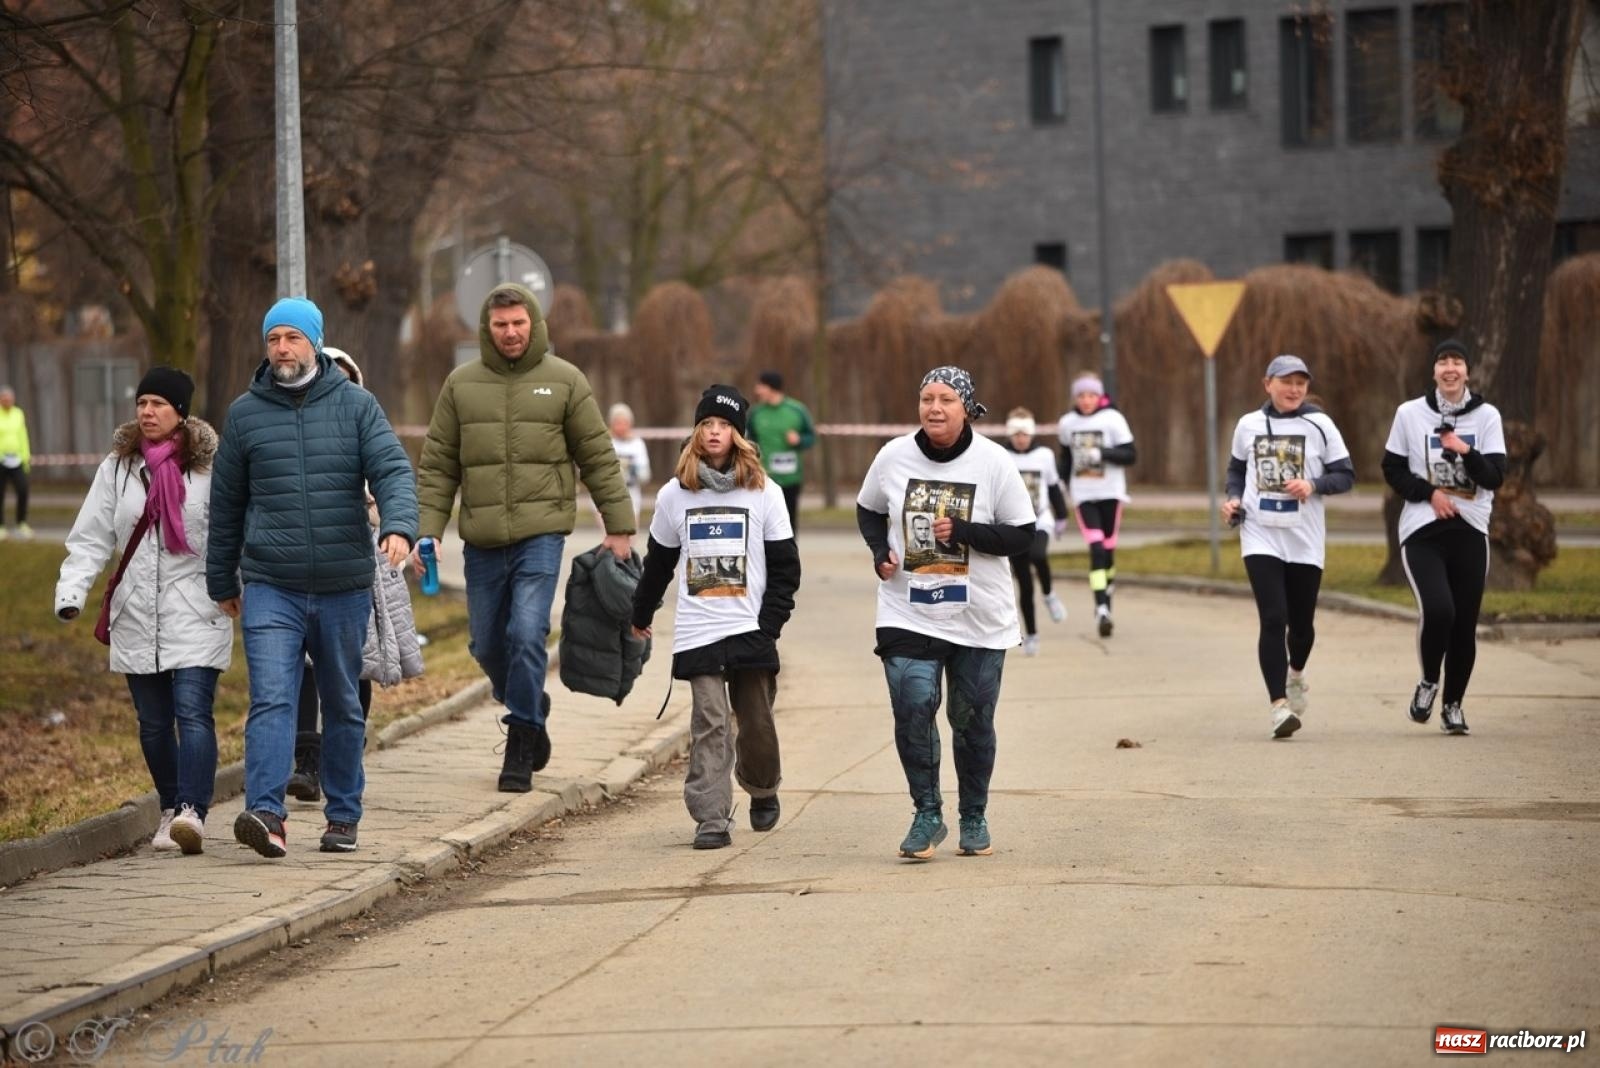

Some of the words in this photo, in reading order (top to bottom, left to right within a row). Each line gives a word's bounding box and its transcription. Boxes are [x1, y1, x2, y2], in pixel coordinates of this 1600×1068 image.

[716, 395, 740, 411] SWAG
[709, 525, 722, 535] 26
[932, 588, 944, 600] 92
